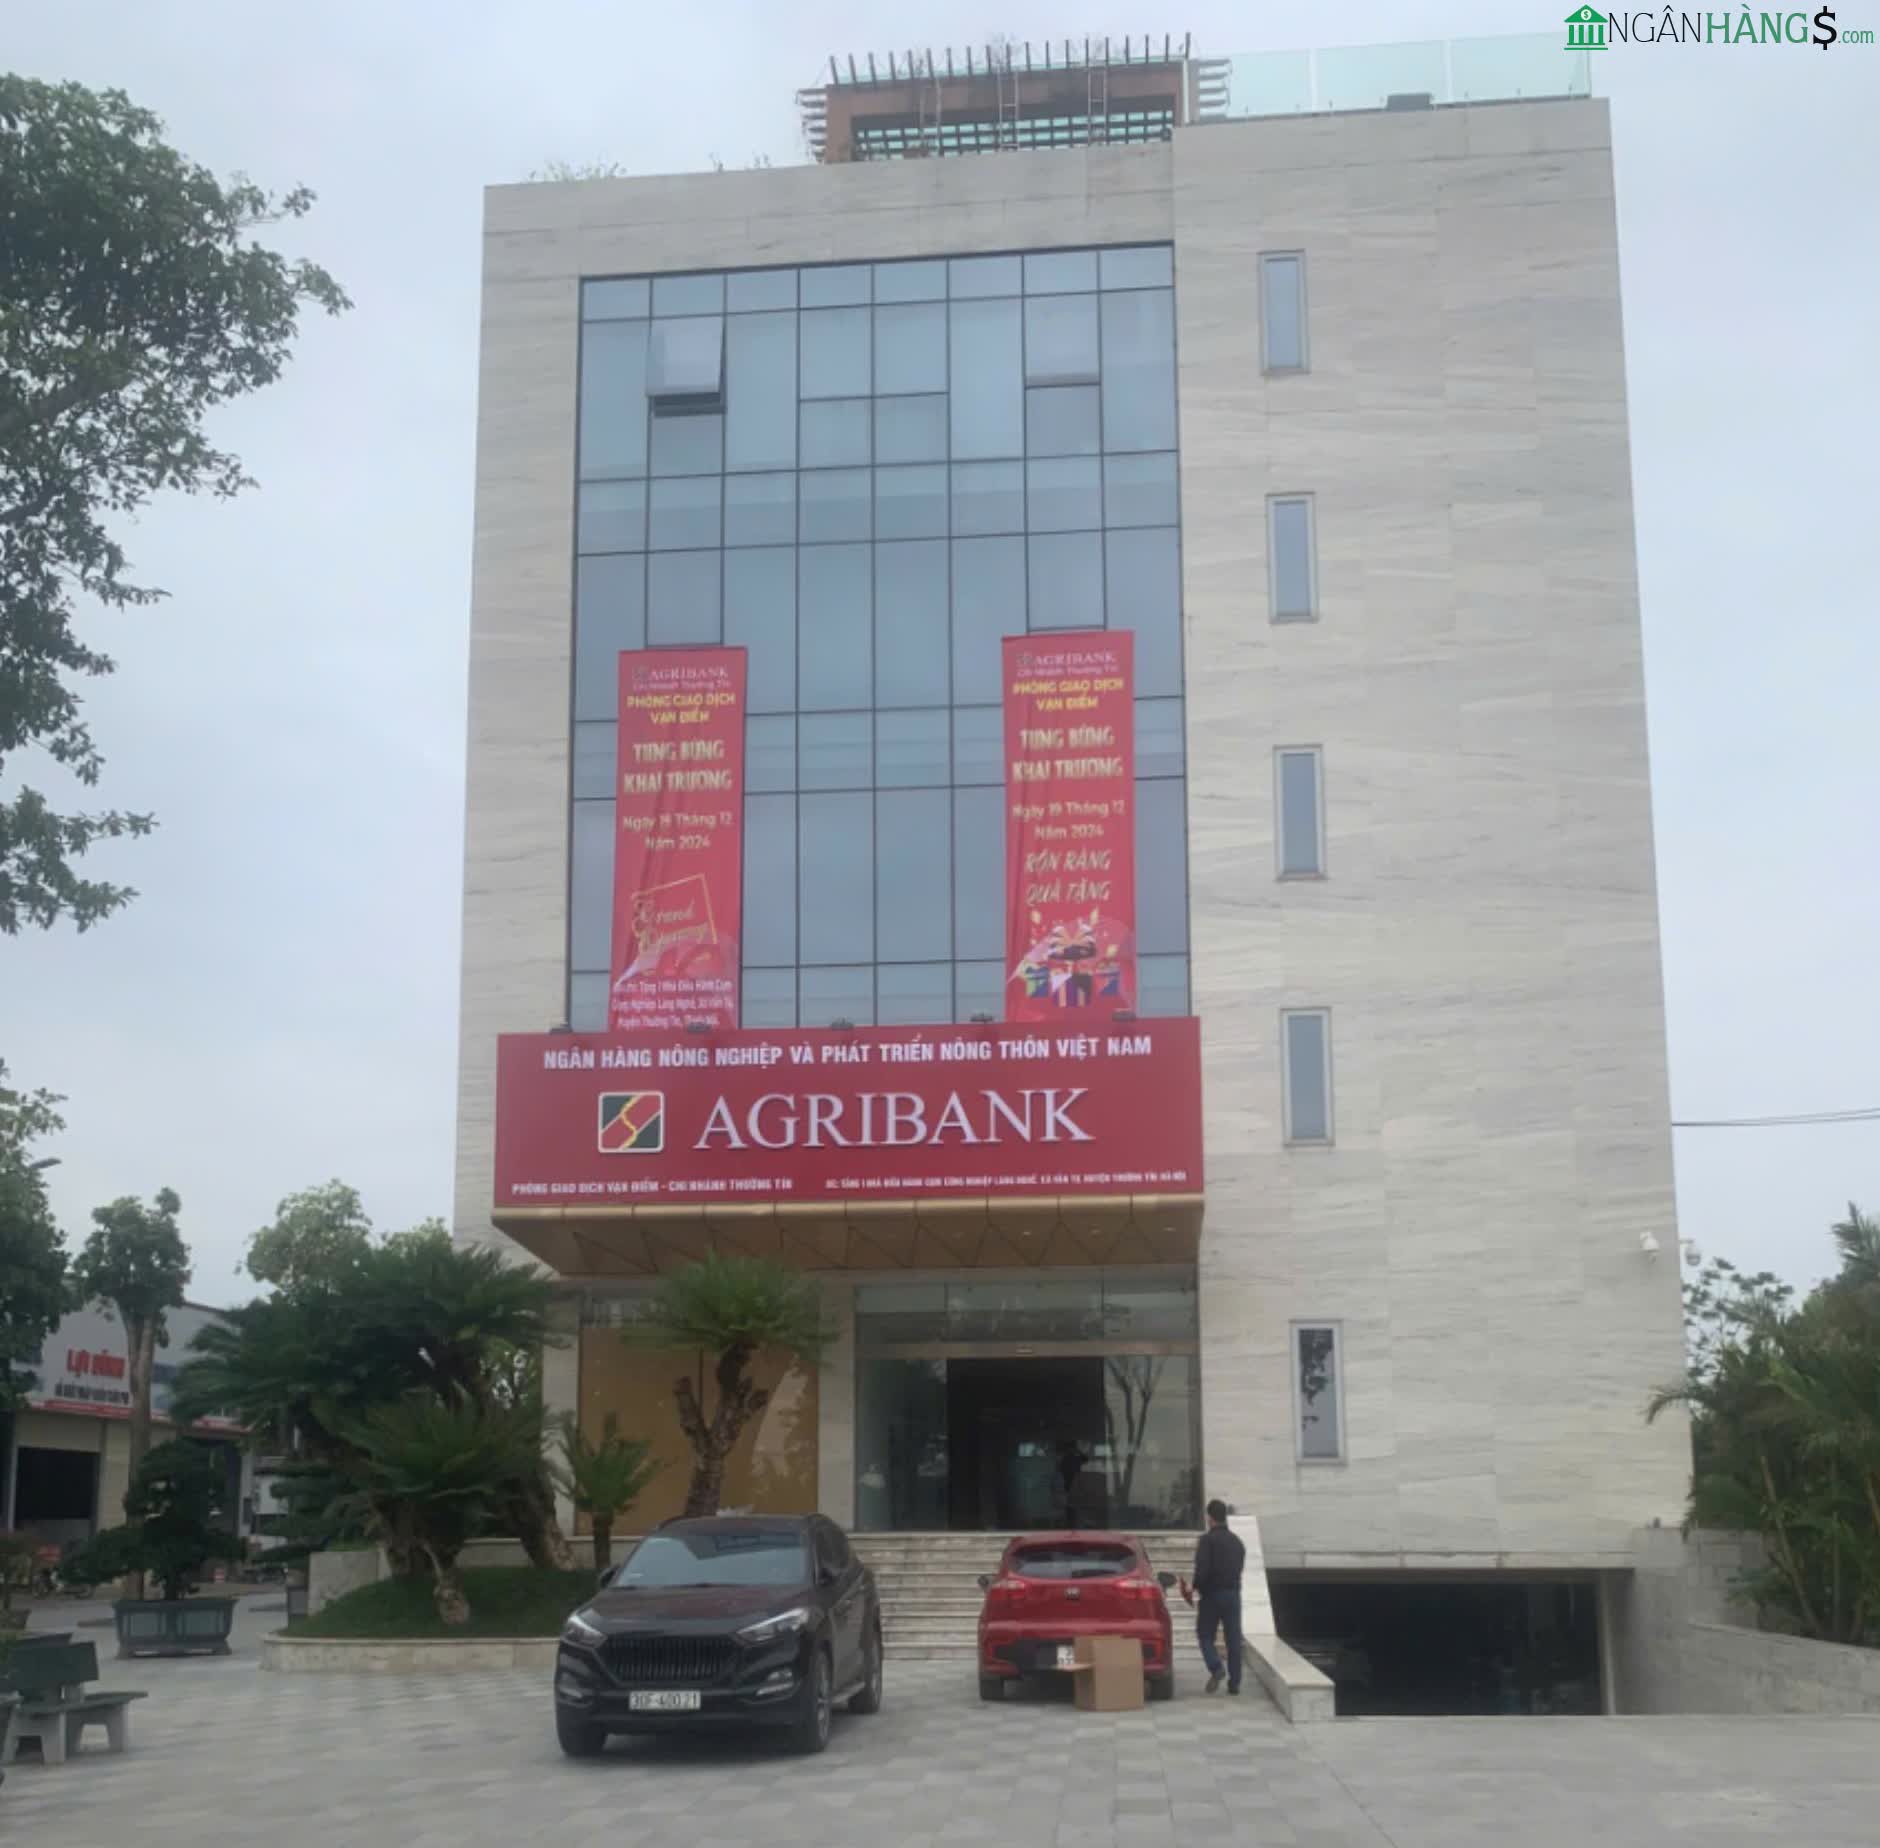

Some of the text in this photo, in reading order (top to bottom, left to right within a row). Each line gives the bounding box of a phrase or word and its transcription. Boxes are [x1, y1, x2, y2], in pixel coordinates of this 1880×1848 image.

[624, 772, 662, 793] KHAI
[1013, 761, 1050, 783] KHAI
[679, 834, 712, 848] 2024
[1071, 823, 1104, 838] 2024
[544, 1033, 1152, 1070] NGÂN HÀNG NÔNG NGHIỆP VÀ PHÁT TRIỂN NÔNG THÔN VIỆT NAM
[692, 1087, 1096, 1150] AGRIBANK
